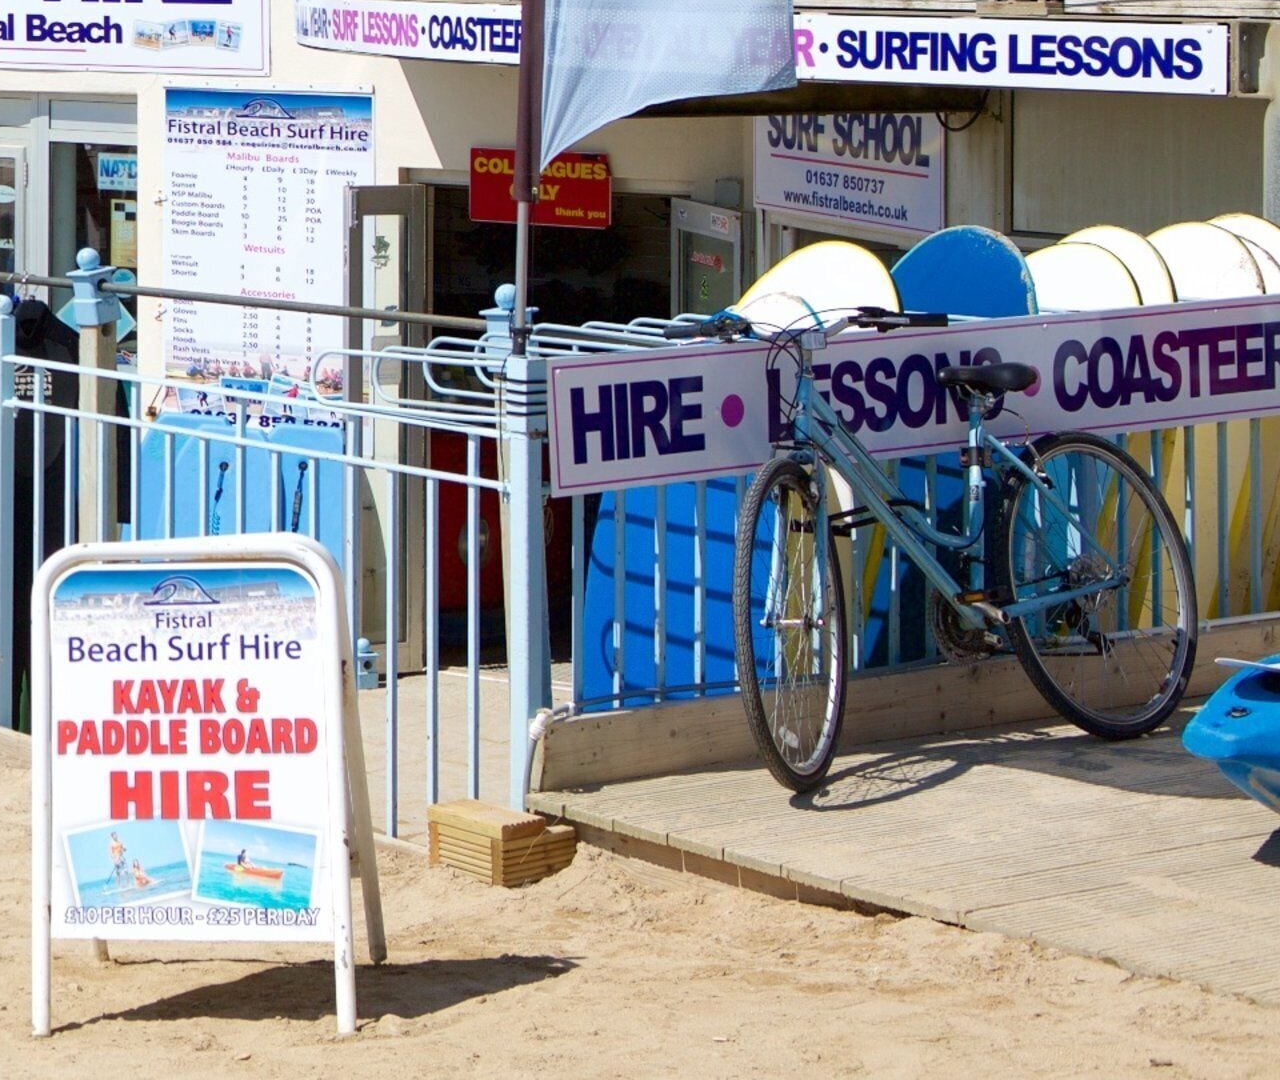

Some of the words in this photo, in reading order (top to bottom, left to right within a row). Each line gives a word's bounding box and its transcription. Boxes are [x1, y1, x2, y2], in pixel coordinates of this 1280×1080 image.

[26, 13, 123, 45] Beach
[332, 9, 358, 42] SURF
[362, 11, 419, 47] LESSONS
[836, 29, 996, 72] SURFING
[1008, 33, 1203, 80] LESSONS
[168, 119, 221, 135] Fistral
[227, 121, 281, 138] Beach
[287, 123, 325, 139] Surf
[330, 125, 369, 142] Hire
[768, 113, 825, 152] SURF
[832, 113, 929, 168] SCHOOL
[226, 152, 260, 162] Malibu
[266, 154, 300, 164] Boards
[806, 170, 839, 188] 01637
[843, 175, 885, 194] 850737
[171, 200, 198, 208] Custom
[171, 210, 198, 218] Paddle
[555, 207, 584, 217] thank
[588, 210, 606, 219] you
[784, 189, 908, 221] www.fistralbeach.co.uk
[171, 219, 198, 227] Boogie
[200, 220, 223, 228] Boards
[244, 244, 286, 254] Wetsuits
[240, 288, 296, 300] Accessories
[173, 326, 194, 334] Socks
[173, 345, 190, 353] Rash
[569, 375, 704, 465] HIRE
[155, 612, 212, 629] Fistral
[67, 635, 158, 663] Beach
[167, 634, 229, 662] Surf
[240, 634, 302, 660] Hire
[112, 679, 225, 714] KAYAK
[236, 679, 260, 713] &
[57, 720, 187, 756] PADDLE
[200, 718, 318, 754] BOARD
[110, 770, 271, 820] HIRE
[65, 907, 98, 924] £10
[101, 907, 136, 924] PER
[139, 907, 193, 925] HOUR
[207, 908, 240, 925] £25
[244, 908, 280, 925] PER
[282, 908, 320, 925] DAY
